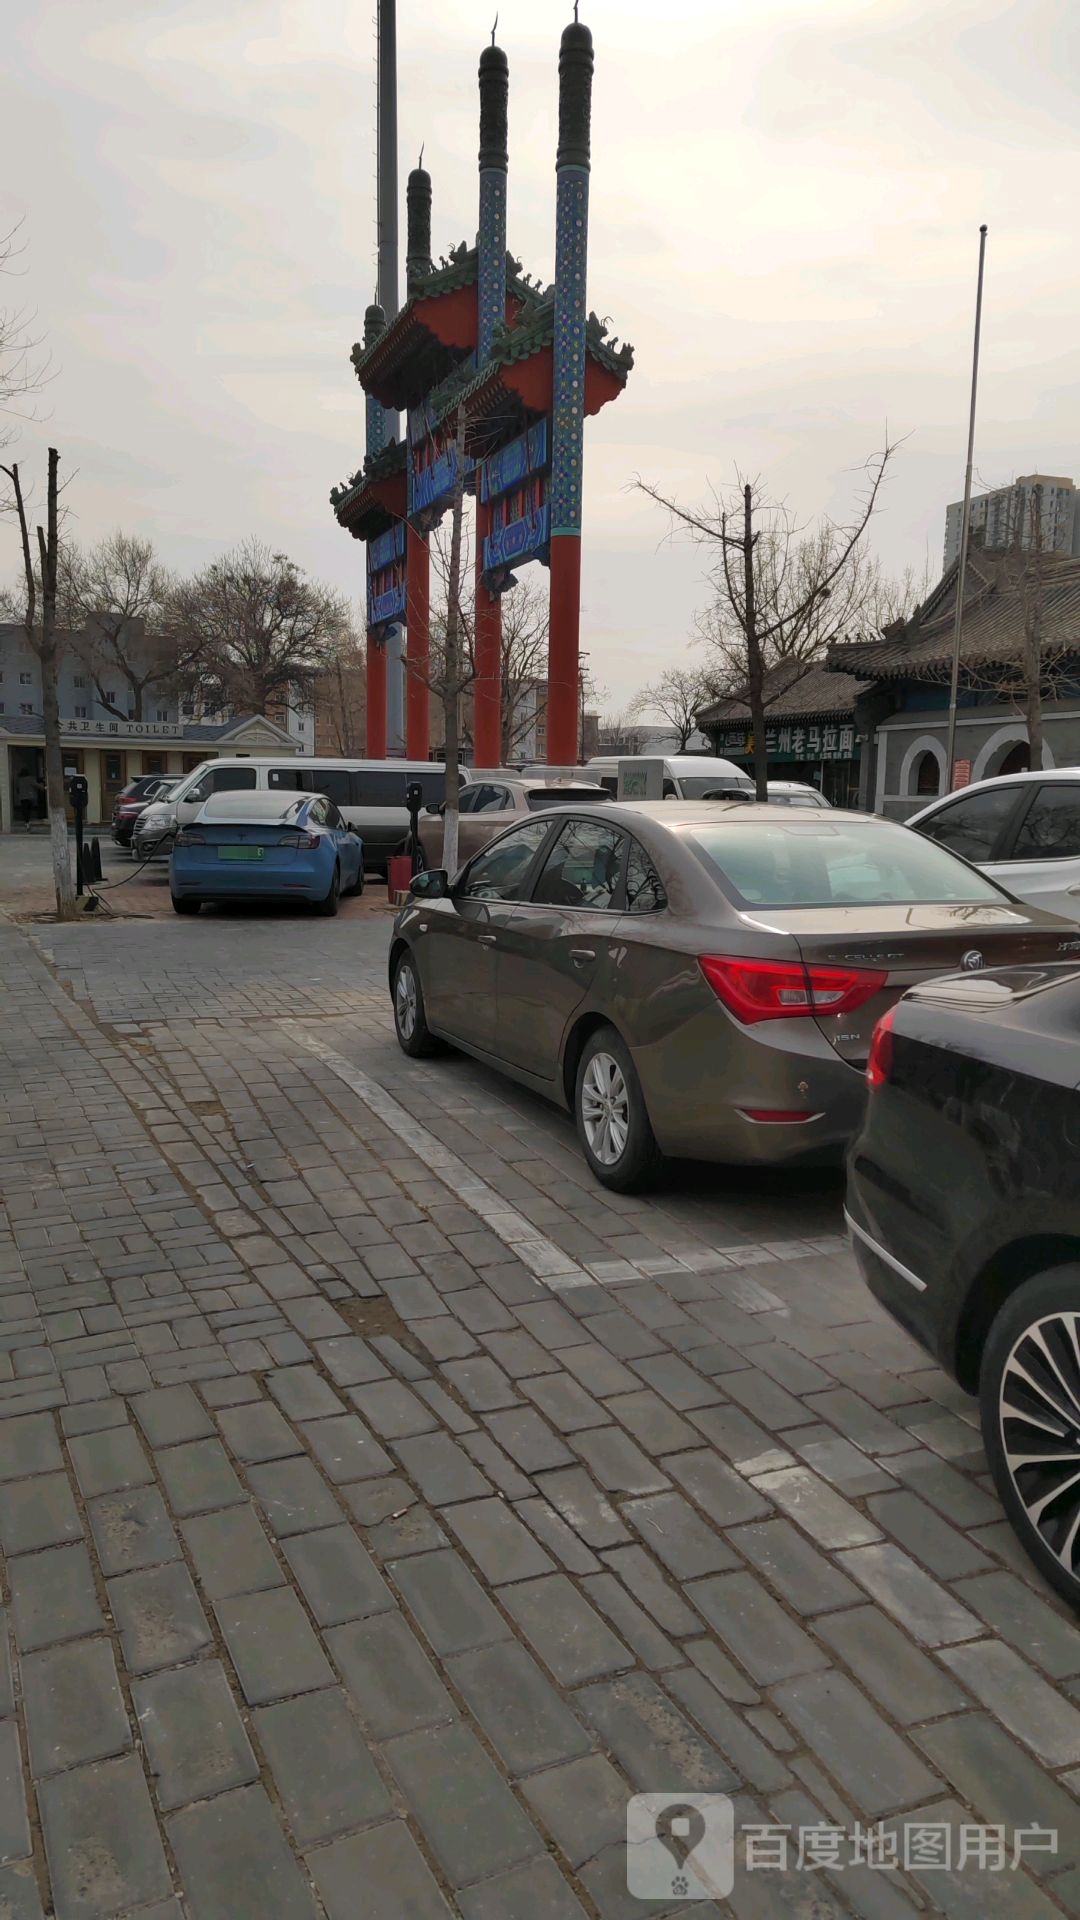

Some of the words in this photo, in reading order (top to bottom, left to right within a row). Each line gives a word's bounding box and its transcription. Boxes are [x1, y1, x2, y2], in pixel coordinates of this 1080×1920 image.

[126, 724, 179, 734] TOILET
[765, 723, 855, 753] 兰州老马拉面
